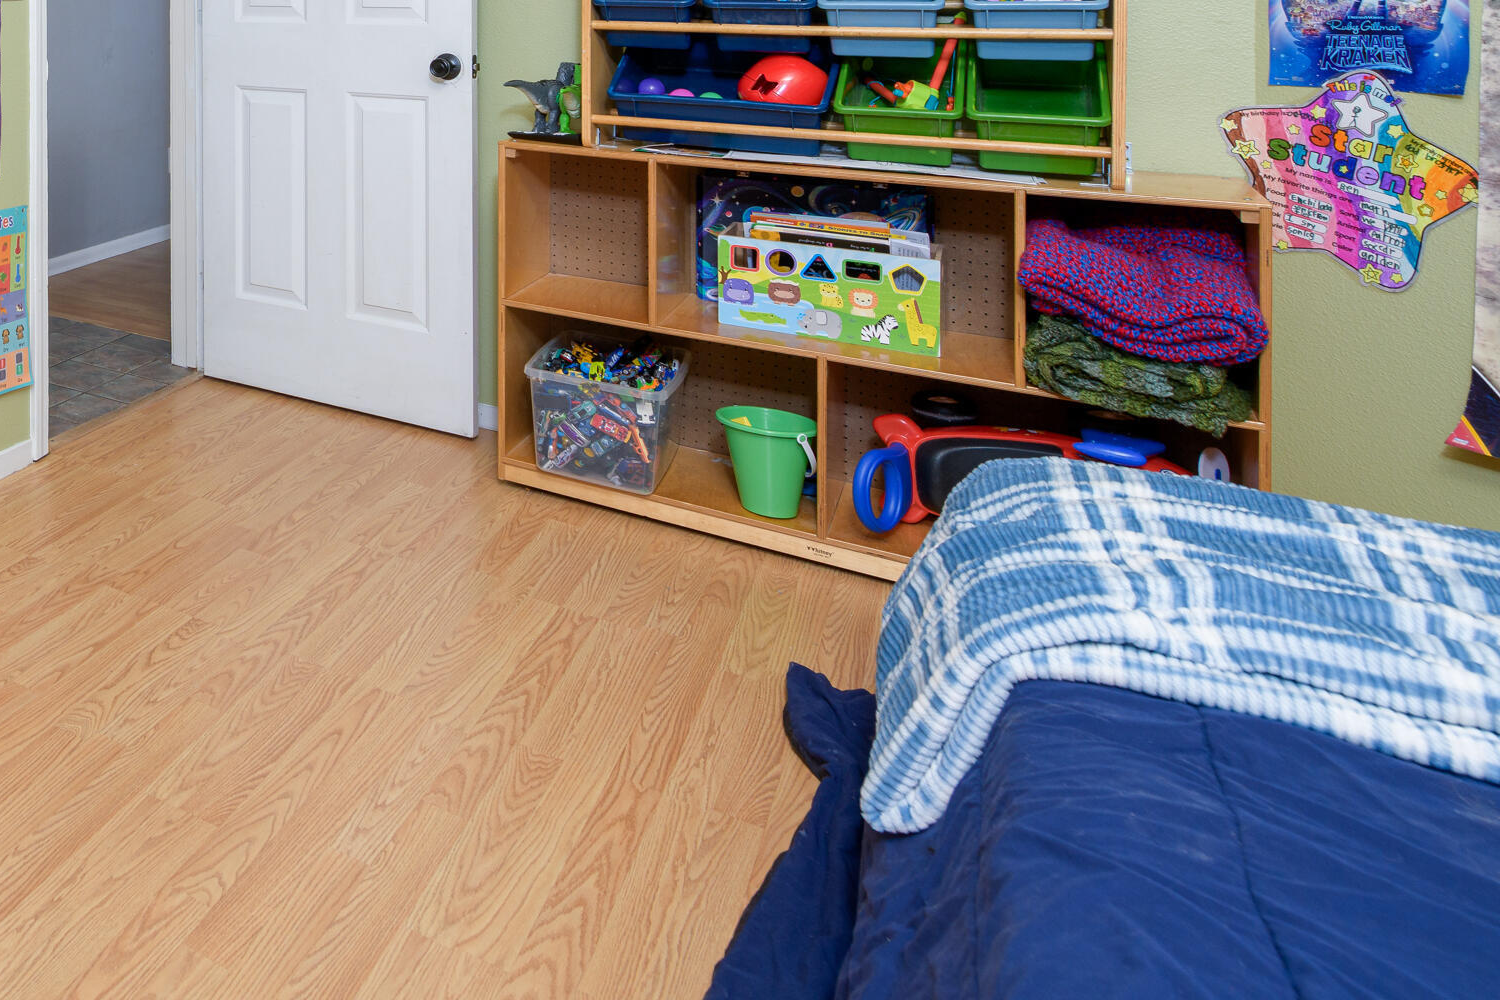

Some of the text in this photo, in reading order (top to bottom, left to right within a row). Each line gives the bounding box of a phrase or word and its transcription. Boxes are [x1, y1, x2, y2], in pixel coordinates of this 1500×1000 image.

[1325, 19, 1403, 34] Ruby Gillman
[1325, 34, 1405, 48] TEENAGE
[1320, 47, 1413, 74] KRAKEN
[1326, 79, 1357, 93] This
[1360, 81, 1372, 94] is
[1250, 110, 1280, 118] birthday
[1309, 124, 1395, 164] Star
[1266, 137, 1427, 201] Student
[1286, 168, 1297, 176] My
[1299, 172, 1323, 182] name
[1266, 188, 1286, 197] Food
[1277, 177, 1310, 191] favorite
[1312, 186, 1337, 199] things
[1340, 210, 1359, 220] Song
[1337, 220, 1366, 233] Animal
[1334, 231, 1356, 242] Sport
